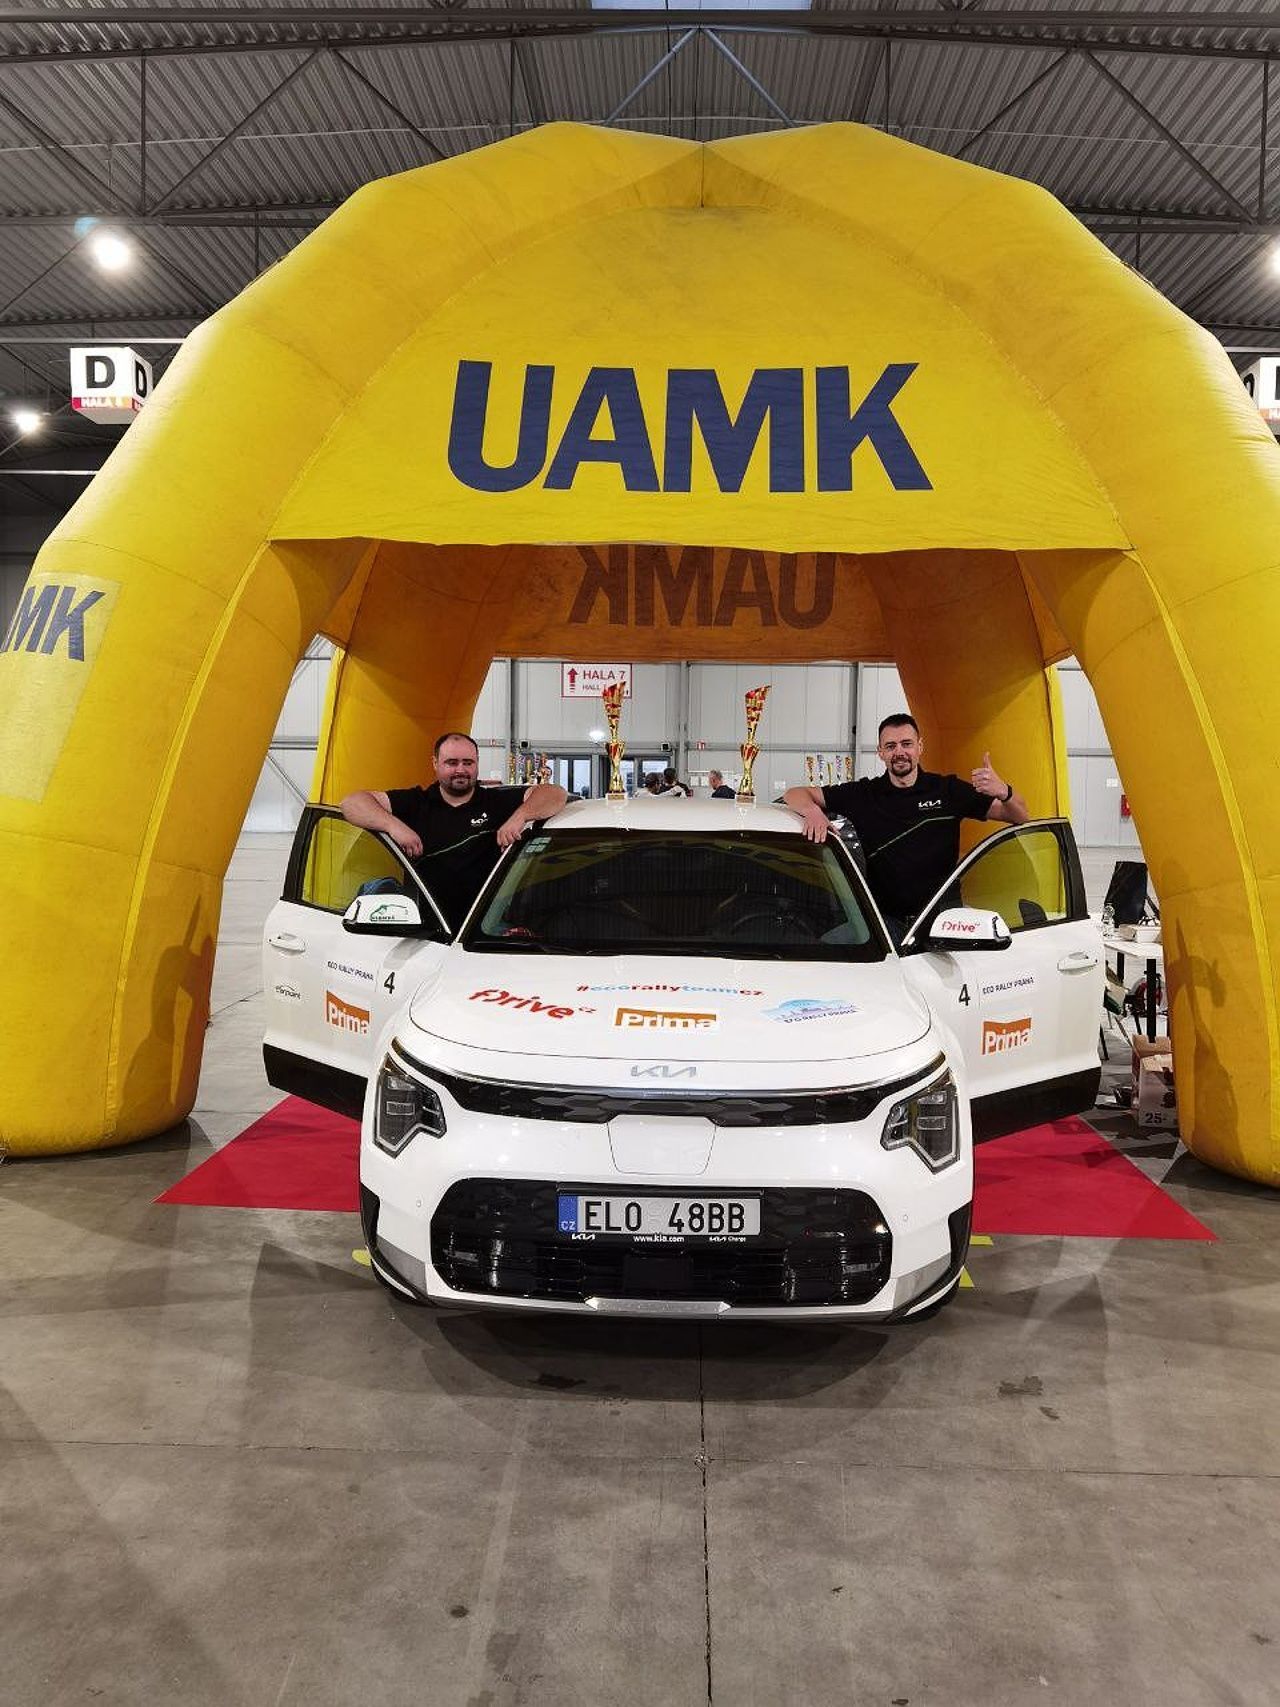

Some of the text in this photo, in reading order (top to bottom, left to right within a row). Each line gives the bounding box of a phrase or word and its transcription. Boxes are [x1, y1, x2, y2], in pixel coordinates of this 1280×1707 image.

[85, 356, 115, 388] D
[135, 360, 147, 398] D
[448, 360, 933, 492] UAMK
[583, 670, 626, 680] HALA 7
[383, 971, 396, 995] 4
[958, 983, 971, 1007] 4
[982, 985, 994, 995] ECO
[995, 980, 1013, 992] RALLY
[328, 1000, 370, 1035] Prima
[620, 1012, 717, 1030] Prima
[983, 1027, 1031, 1056] Prima
[630, 1064, 697, 1078] KIA
[560, 1220, 576, 1231] CZ
[668, 1202, 745, 1233] 48BB
[633, 1232, 685, 1243] www.kia.com
